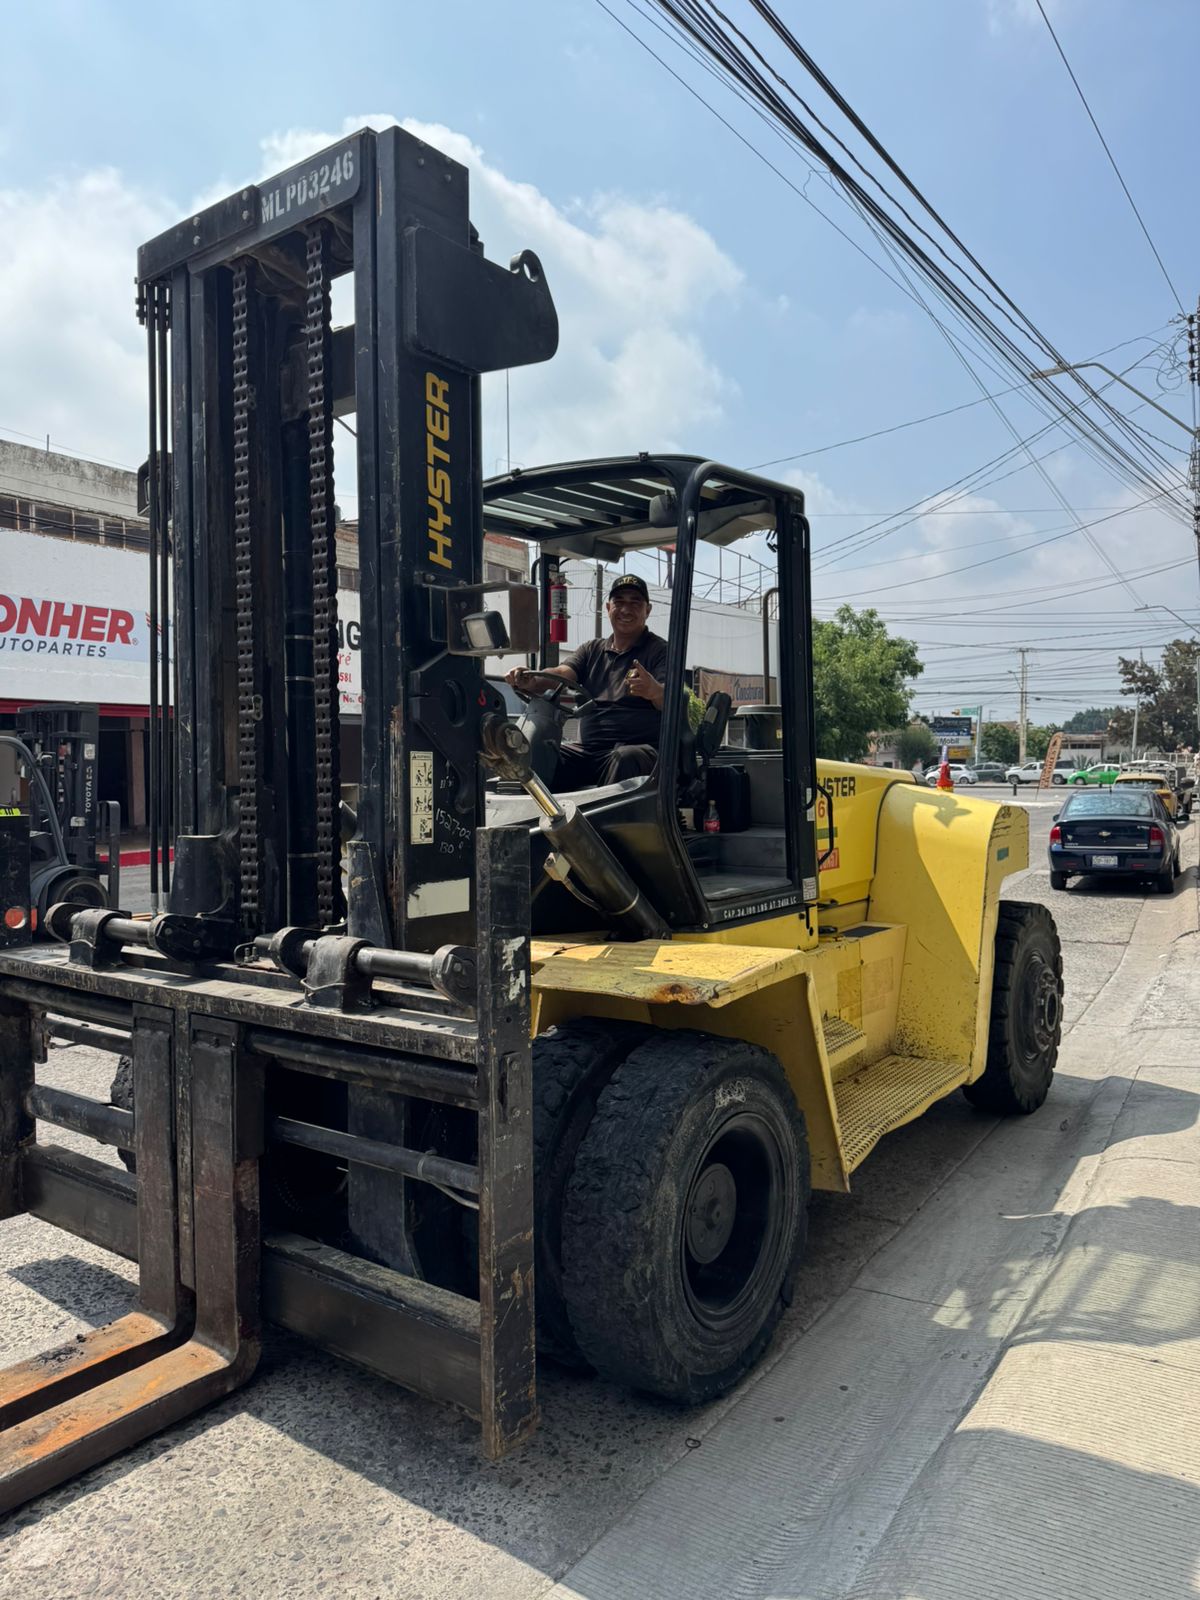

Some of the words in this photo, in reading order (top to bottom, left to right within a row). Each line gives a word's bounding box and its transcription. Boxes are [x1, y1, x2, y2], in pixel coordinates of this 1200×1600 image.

[261, 150, 354, 224] MLP03246
[426, 371, 453, 570] HYSTER
[940, 737, 960, 745] Mobil
